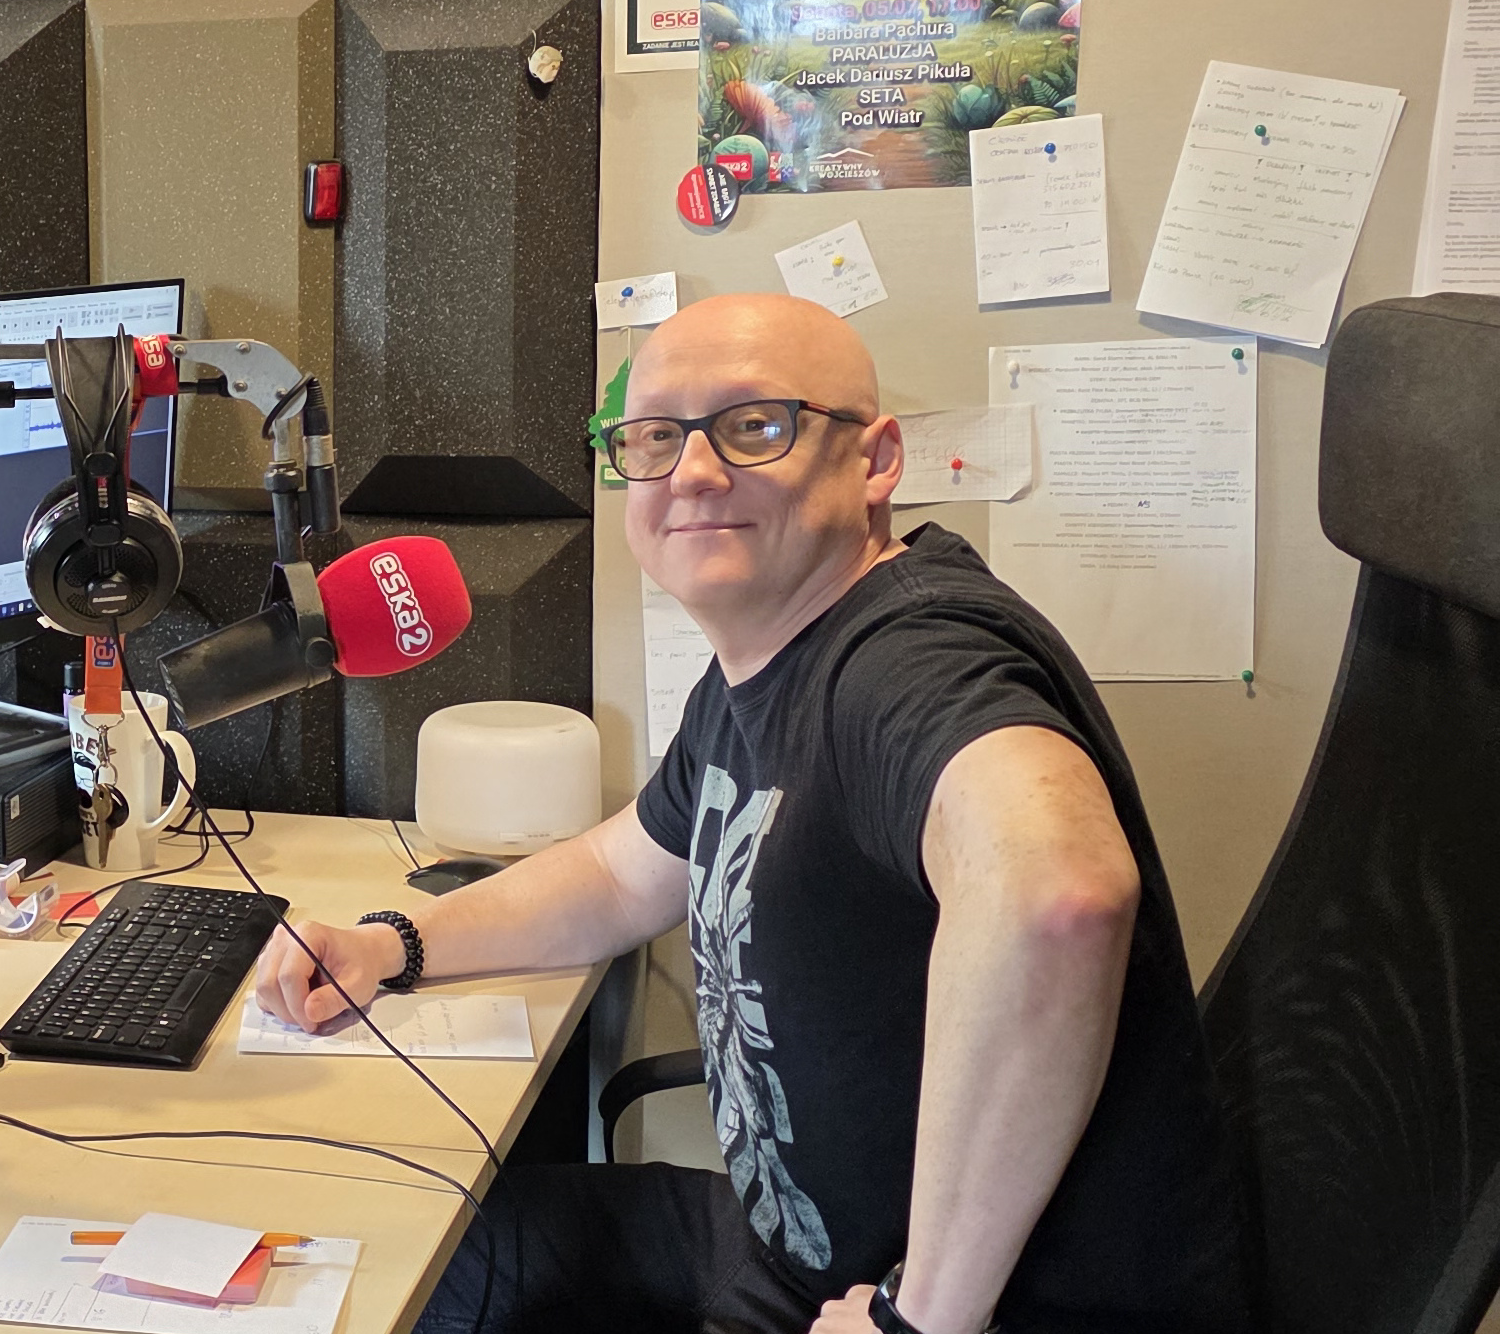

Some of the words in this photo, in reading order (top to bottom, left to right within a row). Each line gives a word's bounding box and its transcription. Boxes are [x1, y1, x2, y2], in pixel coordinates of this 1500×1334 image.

[653, 11, 699, 28] eska
[815, 24, 880, 43] Barbara
[884, 20, 955, 39] Pachura
[832, 41, 936, 63] PARALUZJA
[796, 67, 846, 87] Jacek
[850, 65, 913, 84] Dariusz
[917, 62, 972, 81] Pikuła
[859, 87, 905, 104] SETA
[841, 109, 874, 127] Pod
[878, 108, 924, 126] Wiatr
[809, 162, 864, 173] KREATYWNY
[818, 168, 881, 179] WOJCIESZÓW
[372, 554, 429, 653] eska2
